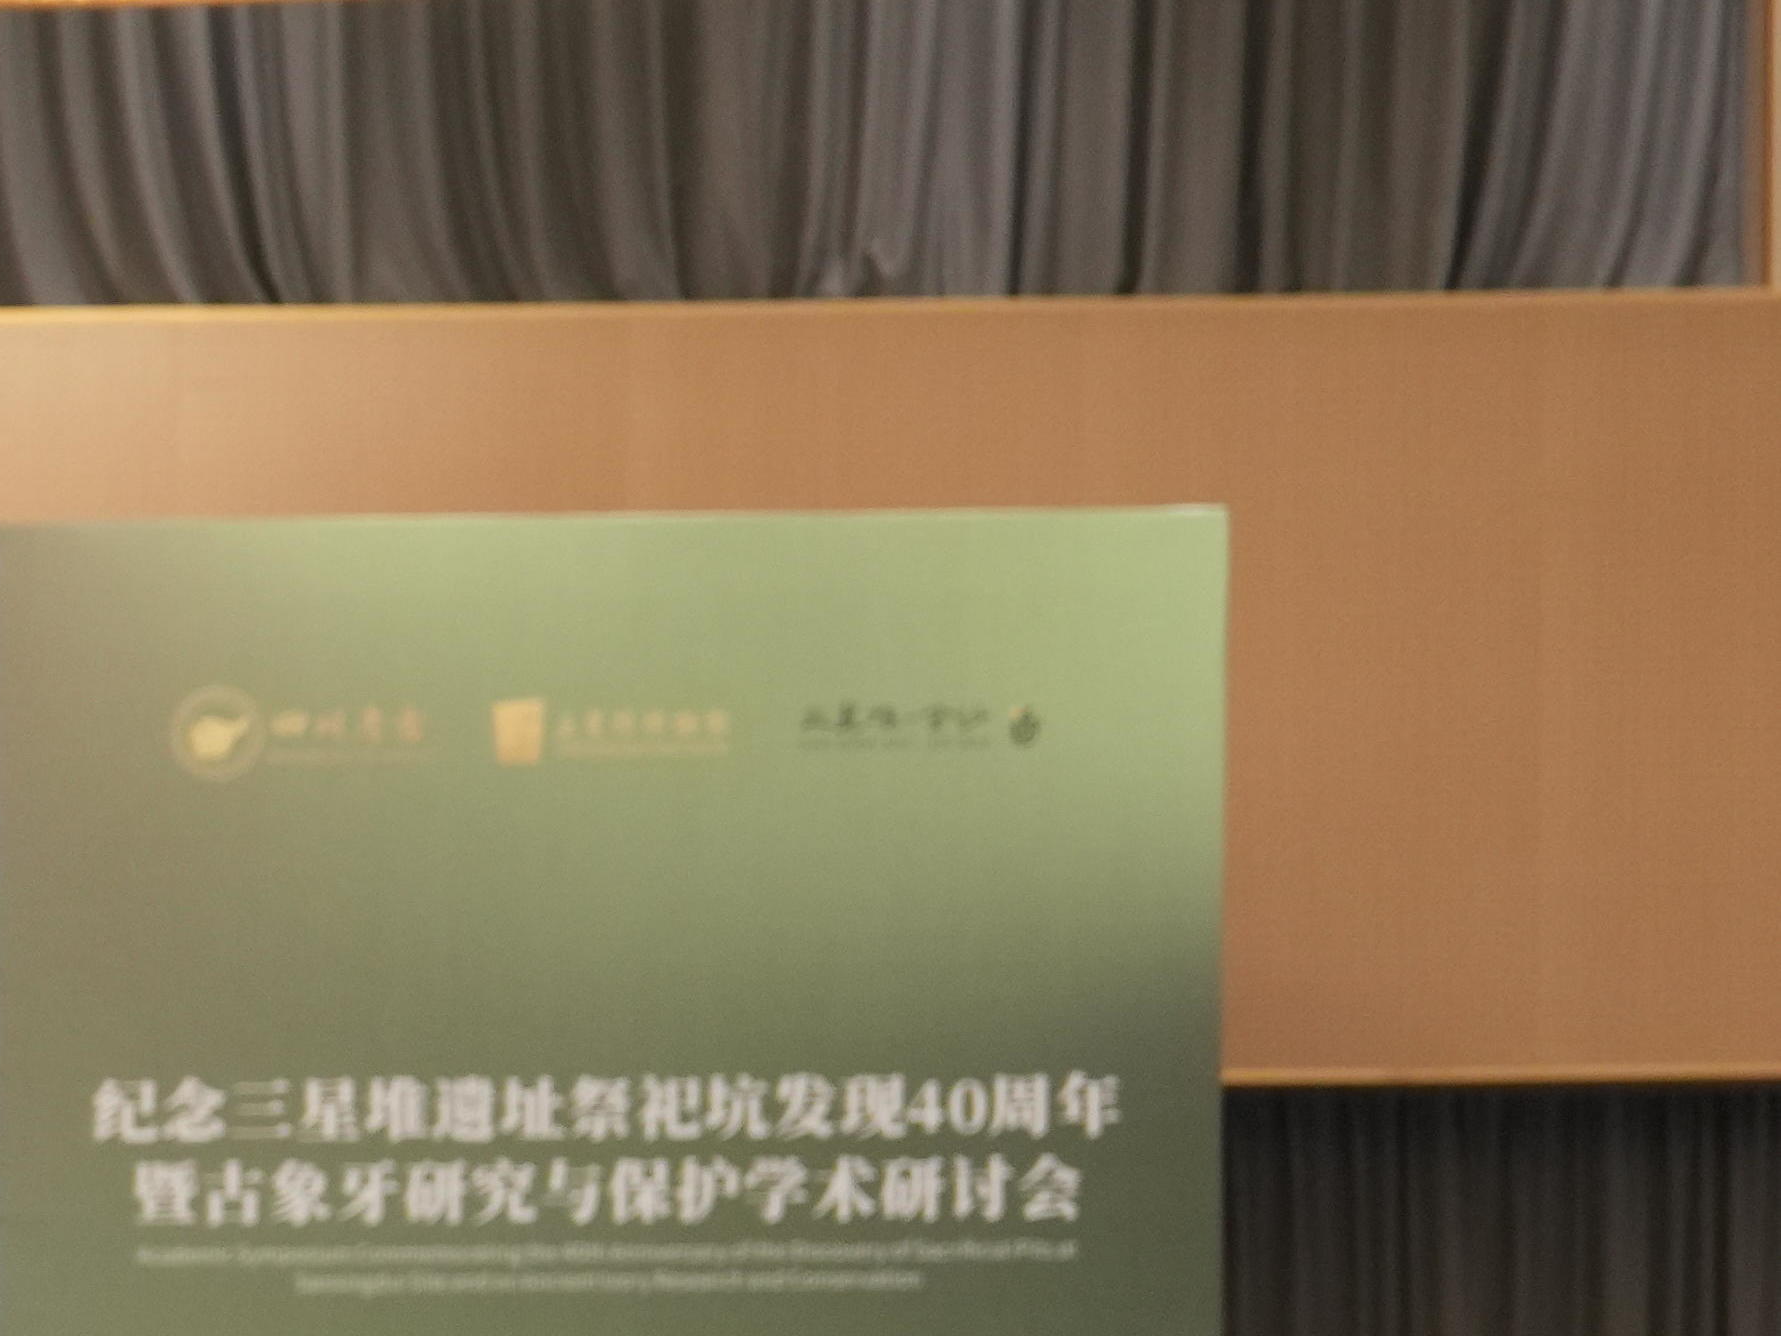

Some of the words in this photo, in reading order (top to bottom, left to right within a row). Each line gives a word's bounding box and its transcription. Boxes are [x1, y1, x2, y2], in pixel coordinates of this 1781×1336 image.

[90, 1070, 1122, 1145] 纪念三星堆遗址祭祀坑发现40周年
[133, 1155, 1083, 1229] 暨古象牙研究与保护学术研讨会
